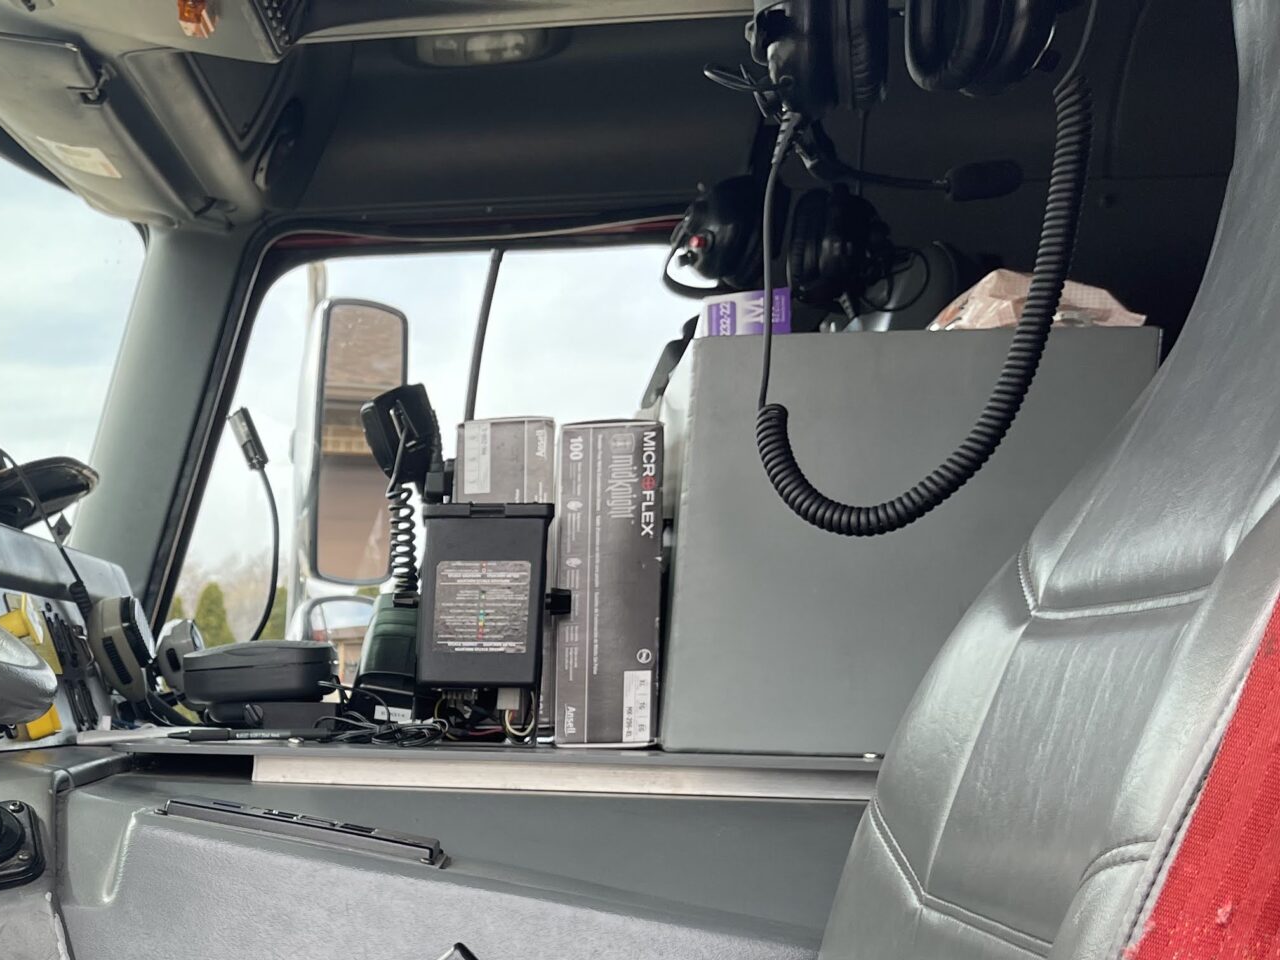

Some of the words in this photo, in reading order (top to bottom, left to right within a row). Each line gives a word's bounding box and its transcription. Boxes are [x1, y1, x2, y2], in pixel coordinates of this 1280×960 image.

[569, 436, 584, 461] 100
[605, 455, 639, 519] midknight
[640, 431, 657, 537] MICROFLEX
[566, 706, 577, 734] Ansell
